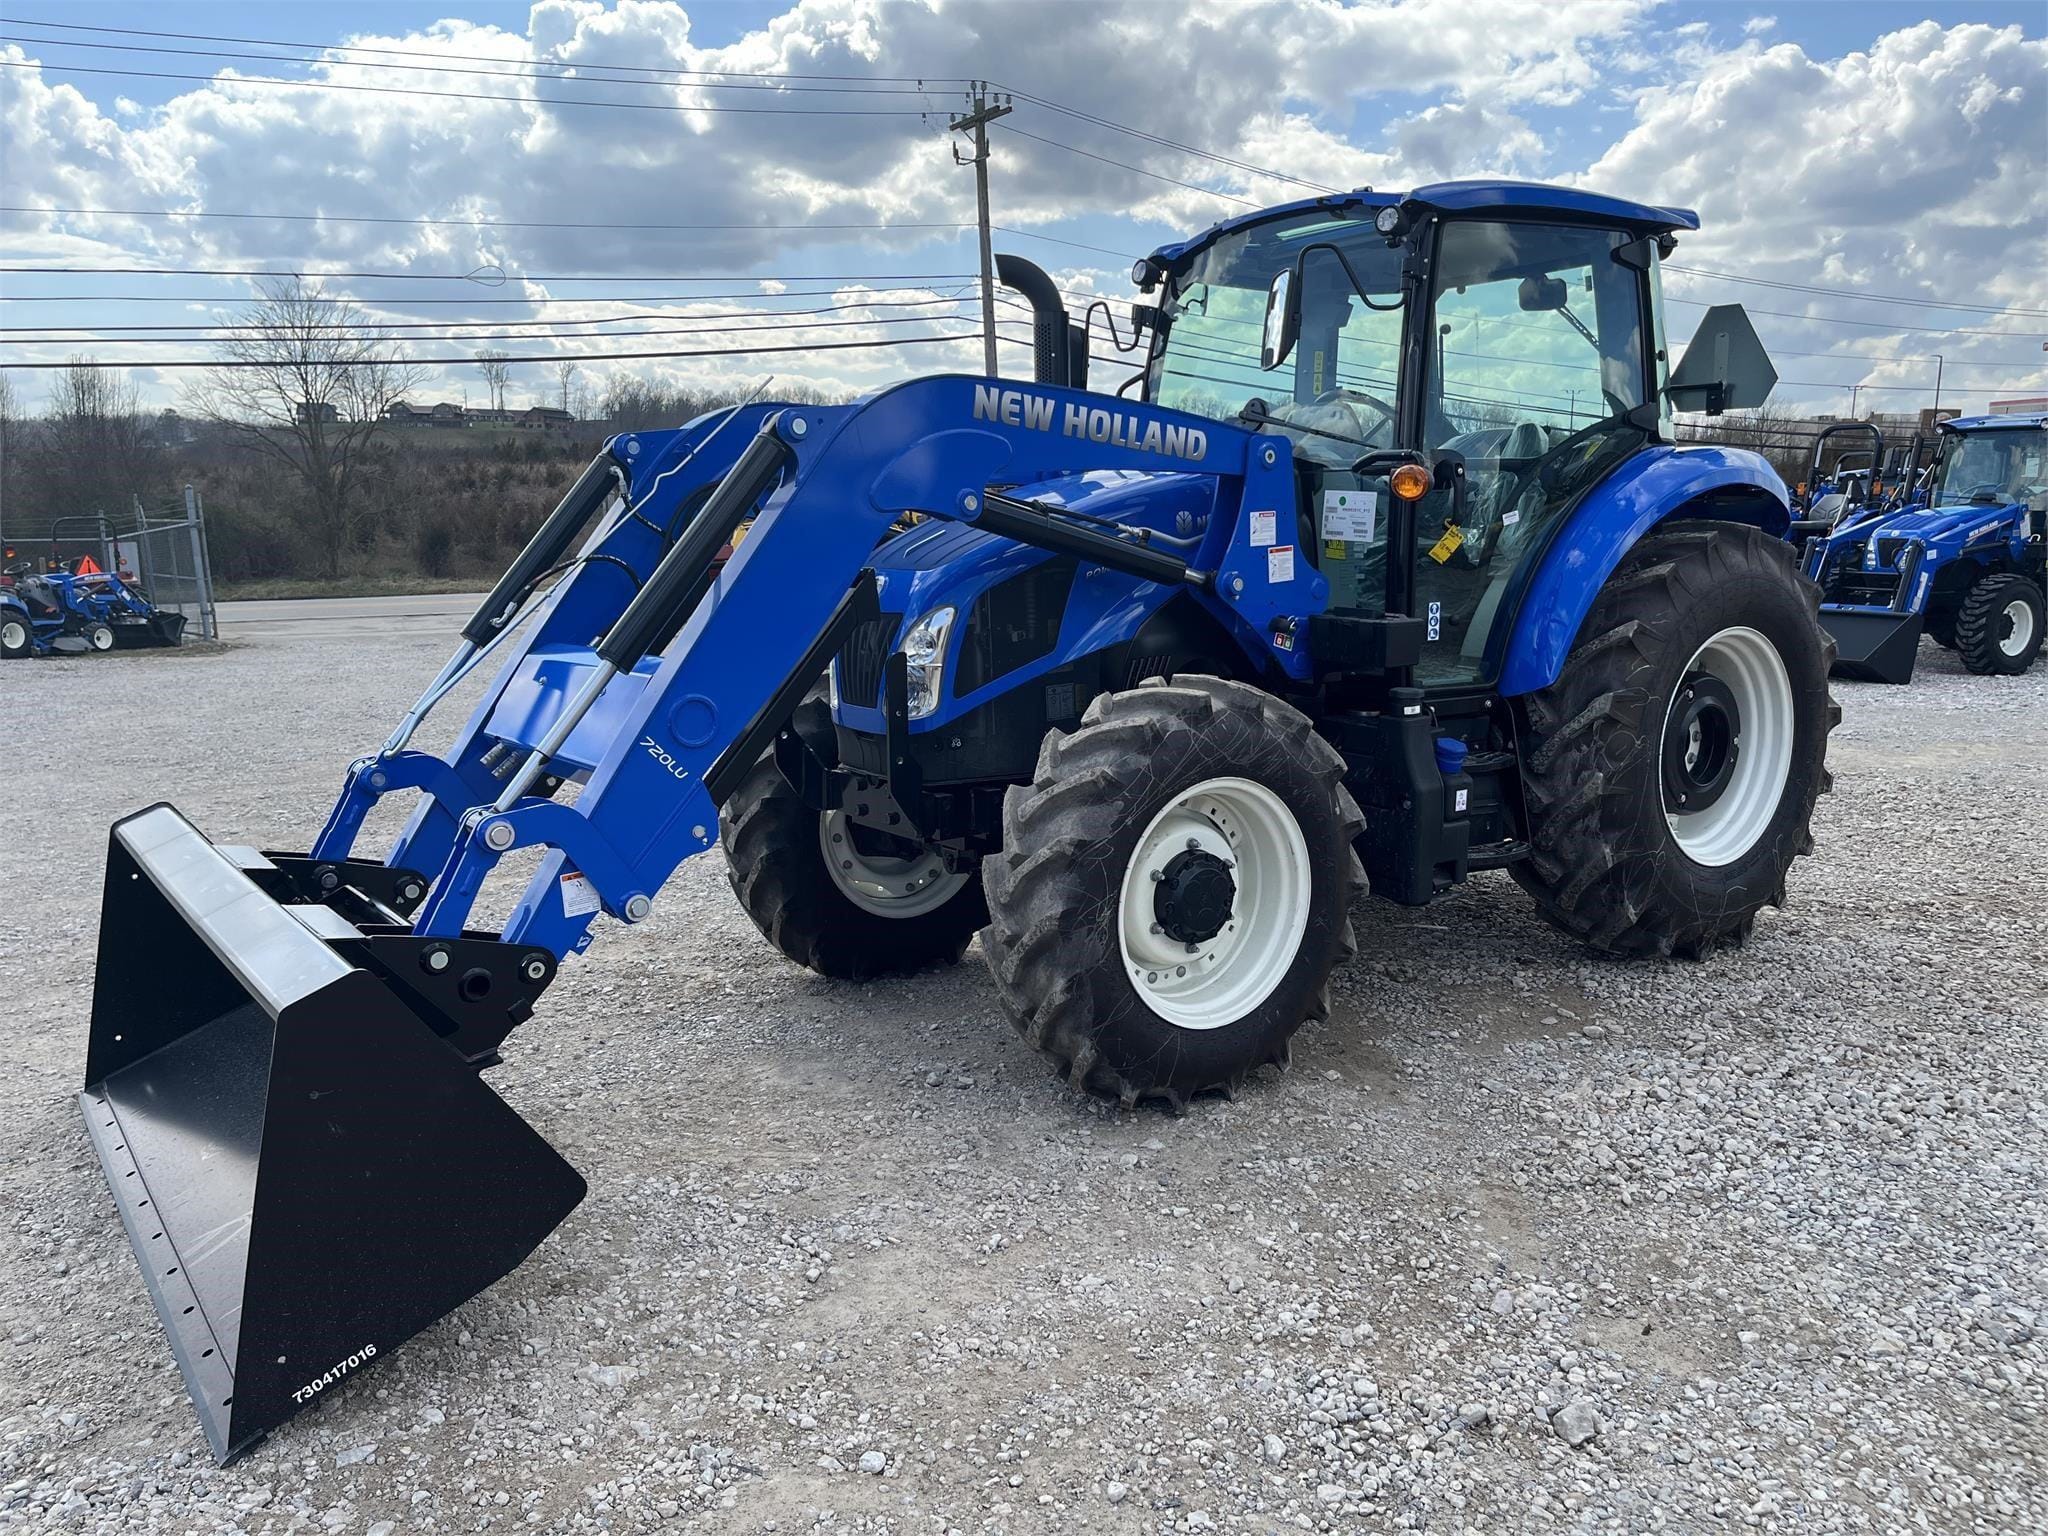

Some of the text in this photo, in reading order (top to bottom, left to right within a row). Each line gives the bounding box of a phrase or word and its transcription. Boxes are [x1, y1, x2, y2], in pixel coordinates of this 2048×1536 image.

[973, 383, 1208, 462] NEW HOLLAND
[639, 735, 689, 779] 720LU
[291, 1343, 377, 1404] 730417016
